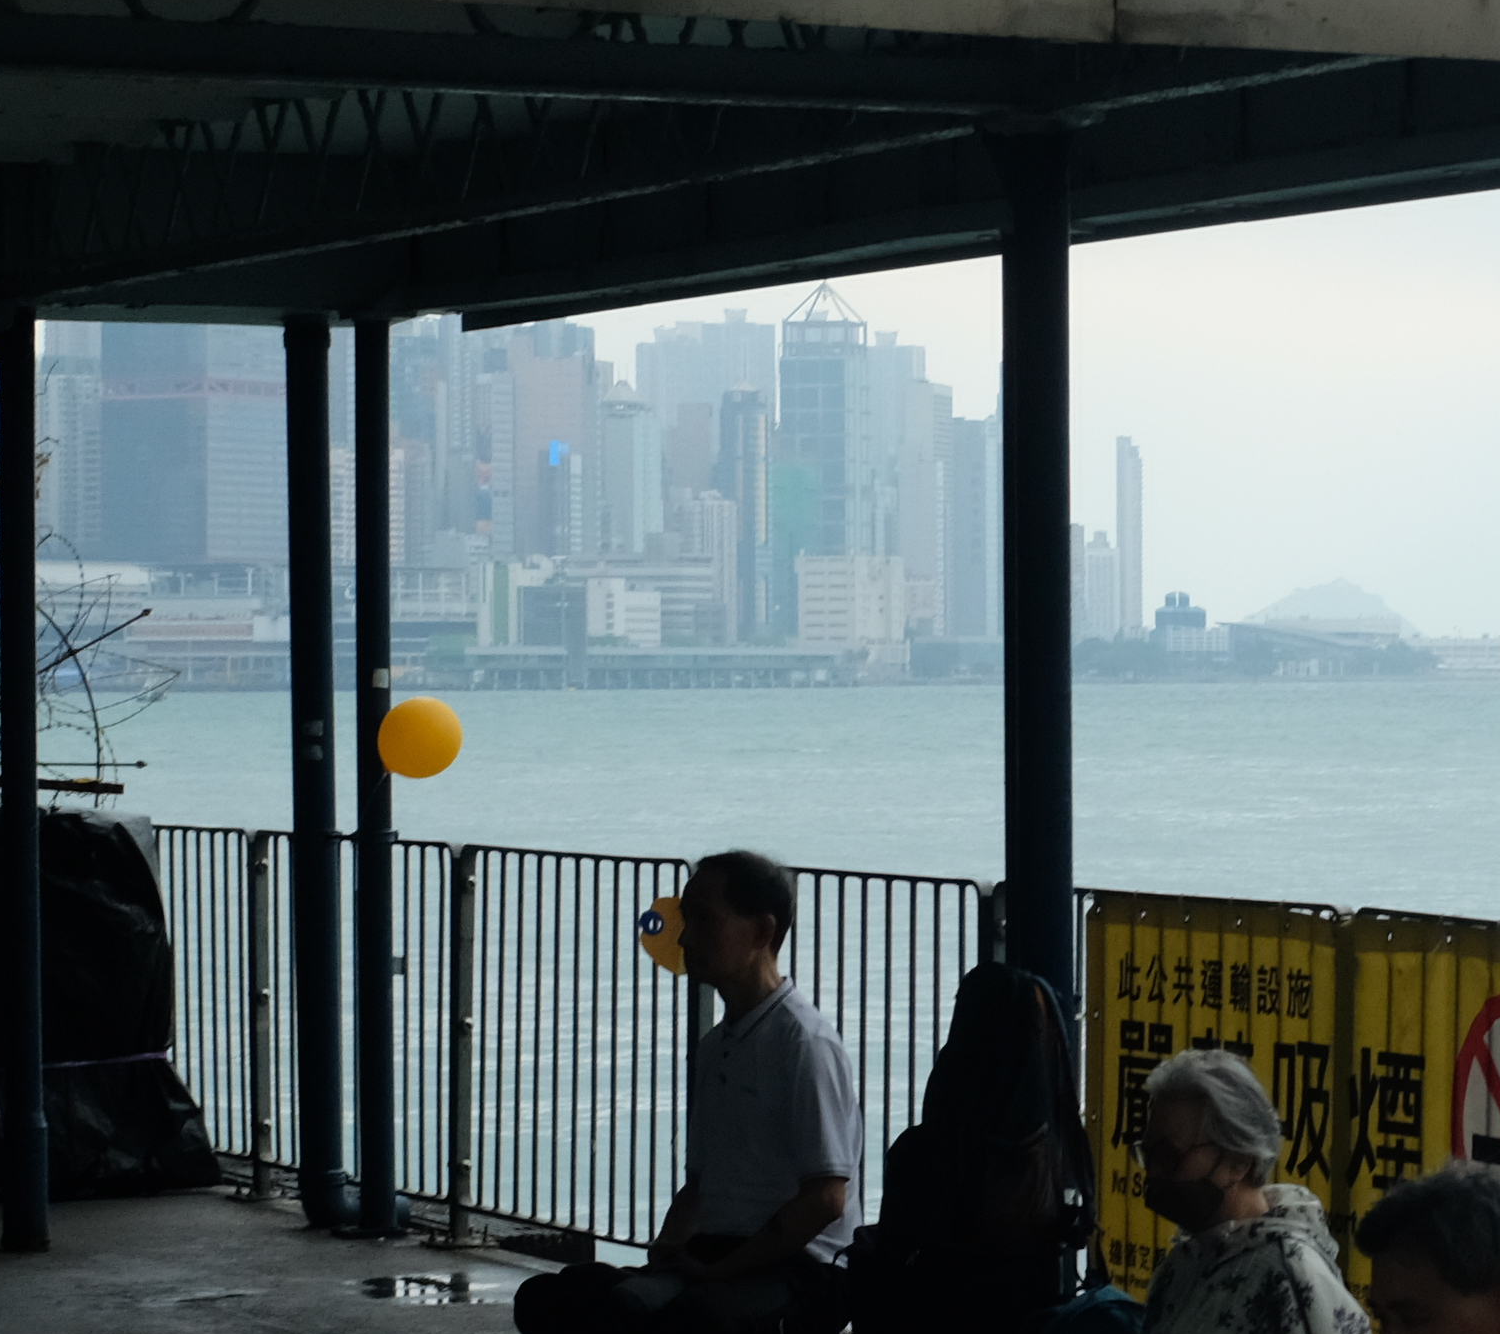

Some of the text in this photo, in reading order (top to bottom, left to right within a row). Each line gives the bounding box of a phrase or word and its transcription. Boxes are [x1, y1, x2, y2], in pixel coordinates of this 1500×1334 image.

[1117, 951, 1313, 1019] 此公共運輸設施
[1110, 1019, 1426, 1189] 嚴吸煙
